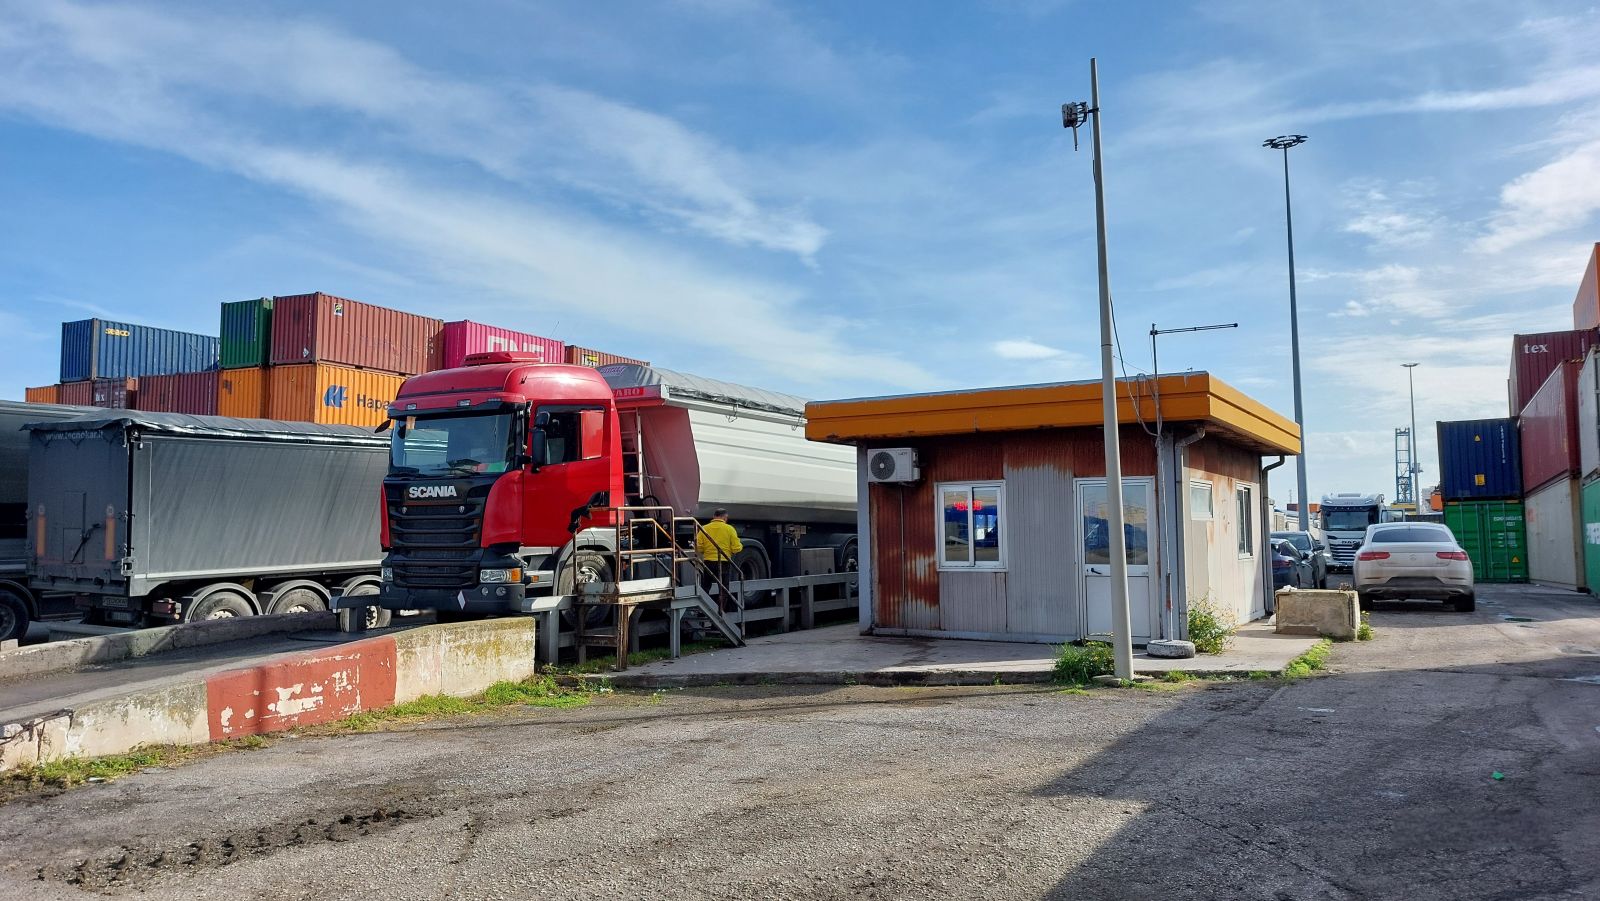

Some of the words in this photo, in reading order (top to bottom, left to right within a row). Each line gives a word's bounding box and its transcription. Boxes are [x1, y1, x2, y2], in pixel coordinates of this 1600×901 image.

[1523, 343, 1549, 354] tex
[612, 387, 642, 399] ARO
[408, 485, 458, 499] SCANIA
